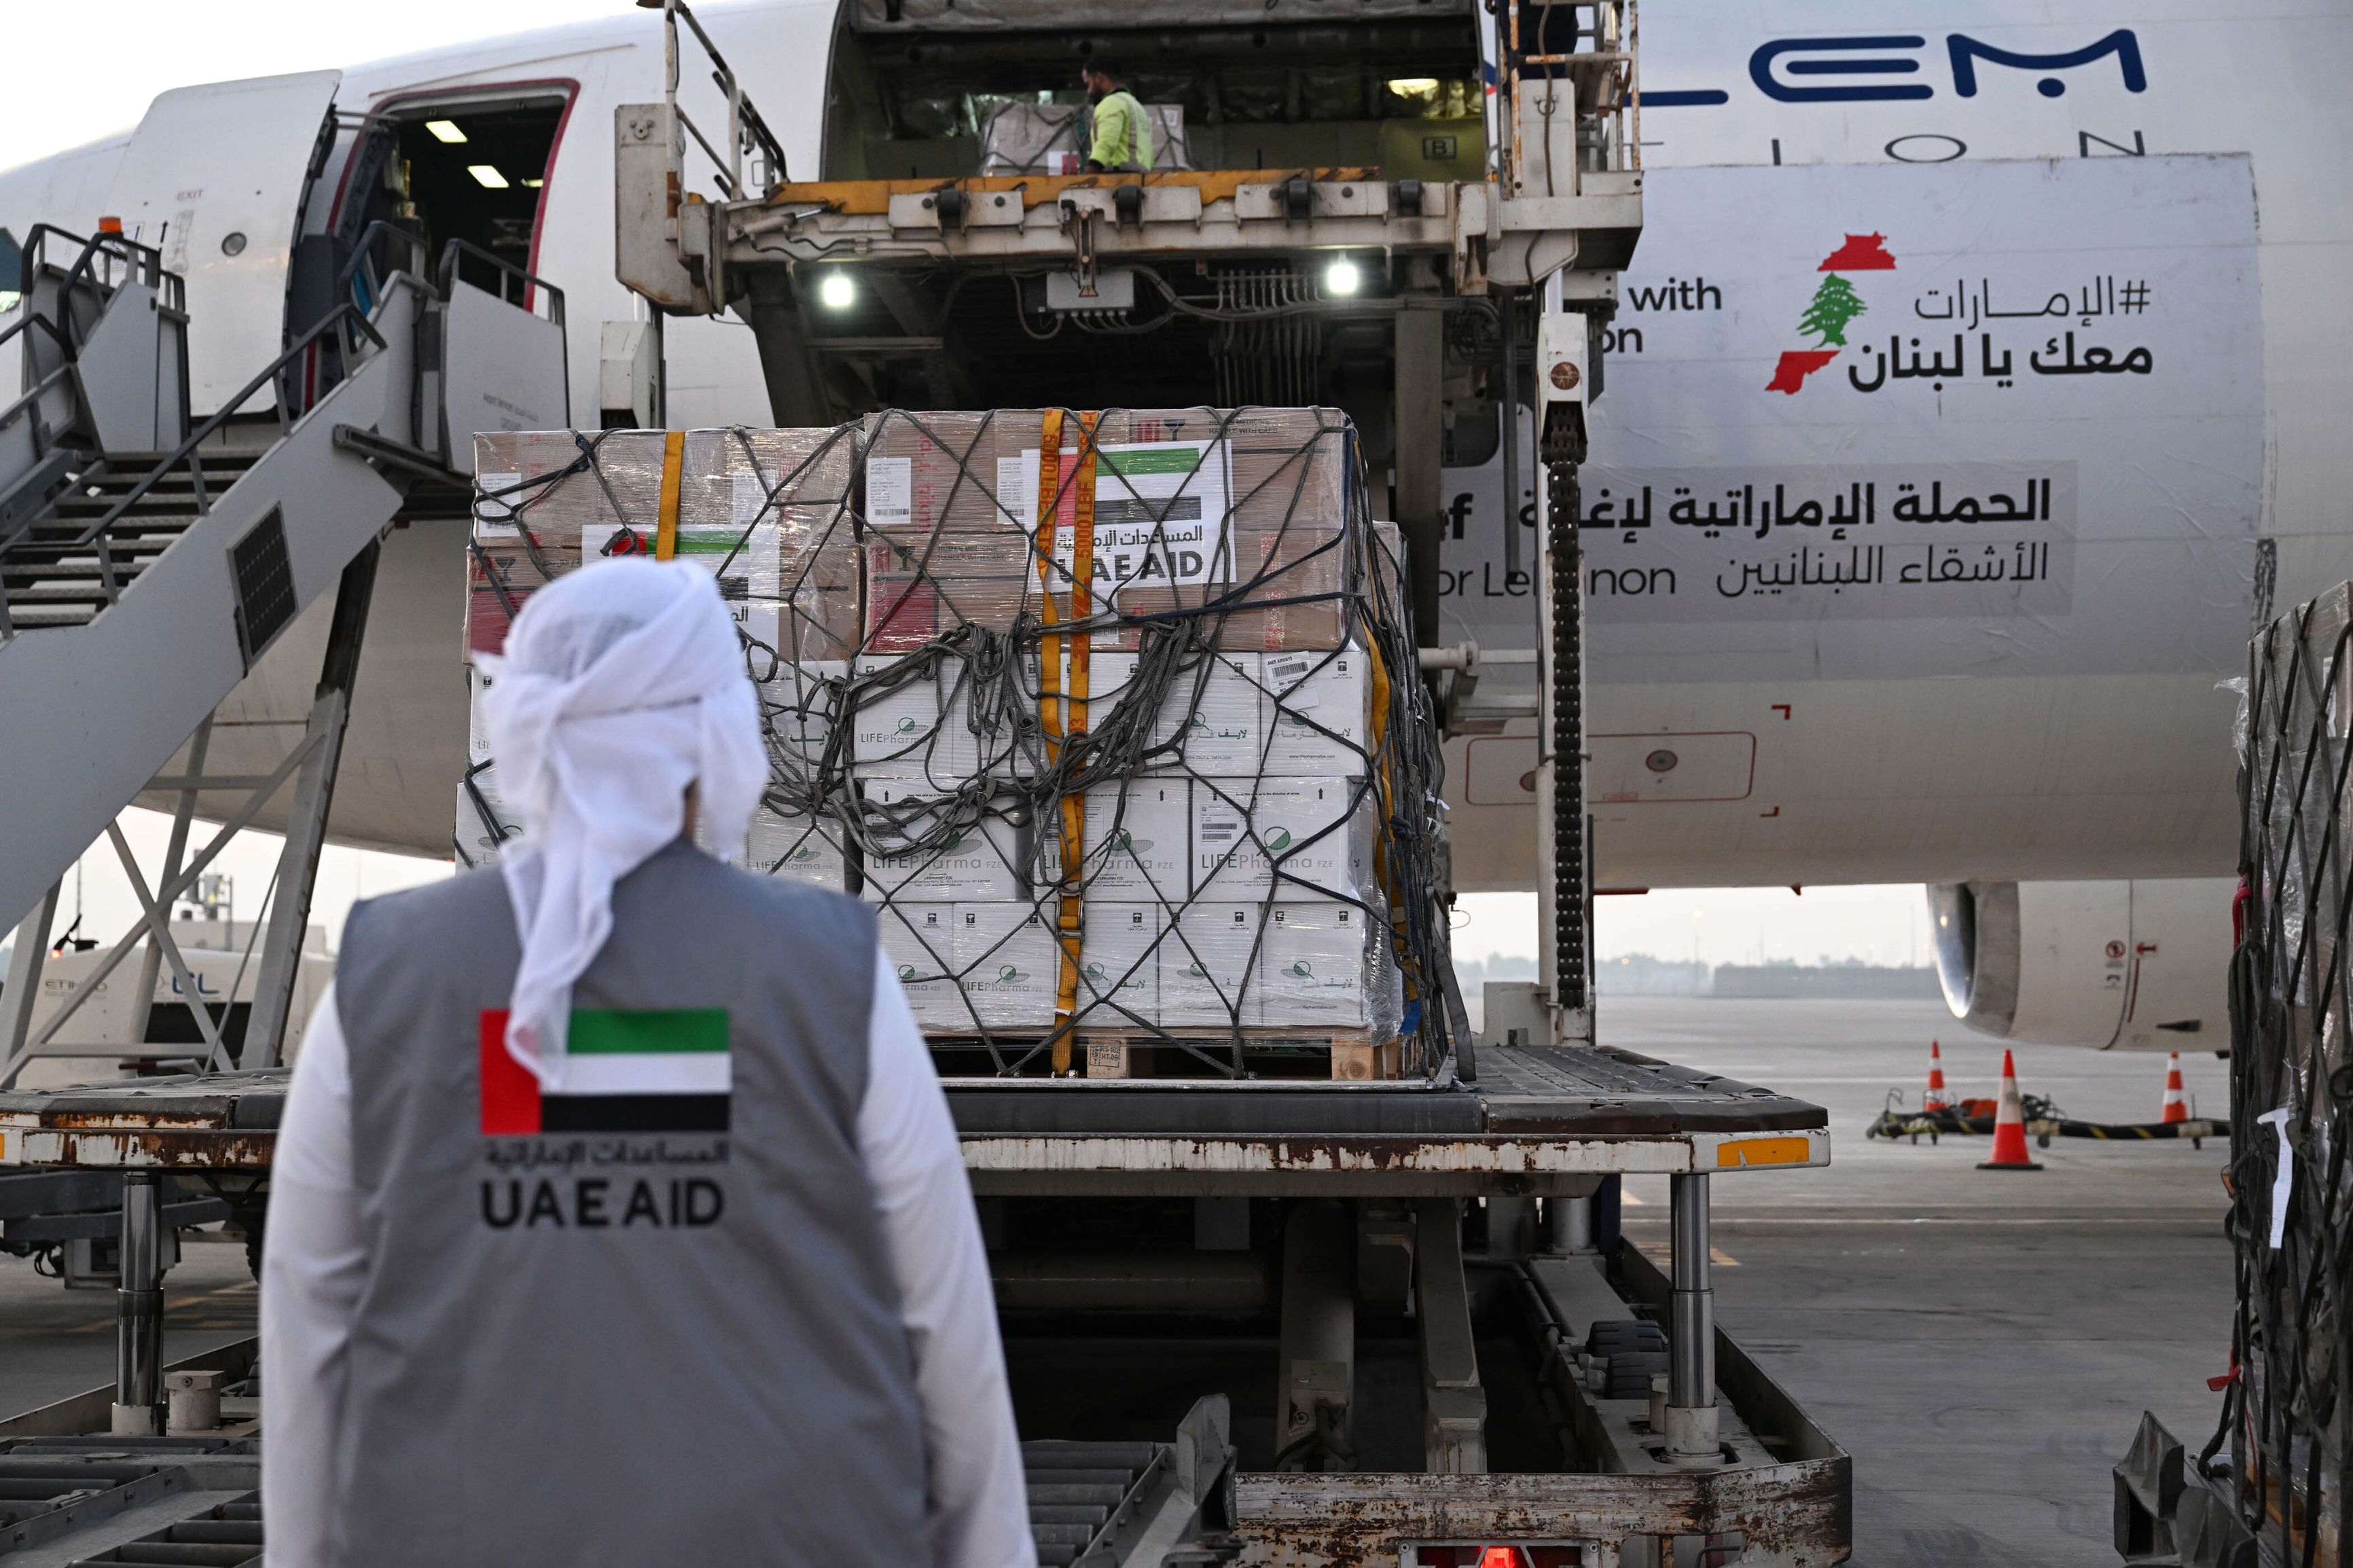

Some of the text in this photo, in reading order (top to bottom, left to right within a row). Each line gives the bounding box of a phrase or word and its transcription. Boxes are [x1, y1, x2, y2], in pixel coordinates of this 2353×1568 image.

[1433, 140, 1447, 155] B
[1628, 276, 1722, 311] with
[1914, 274, 2151, 331] #الإمارات
[1849, 331, 2153, 394] معك يا لبنان
[1041, 433, 1058, 472] 5000
[1077, 481, 1093, 515] LBF
[1668, 483, 1875, 541] الإماراتية
[1892, 478, 2050, 524] الحملة
[1075, 519, 1093, 559] 5000
[1119, 525, 1203, 546] المساعدات
[1138, 551, 1203, 580] AID
[1716, 541, 2049, 598] الأشقاء اللبنانيين
[1218, 728, 1247, 740] لايف
[986, 860, 1002, 869] FZE
[482, 1178, 725, 1228] UAE AID
